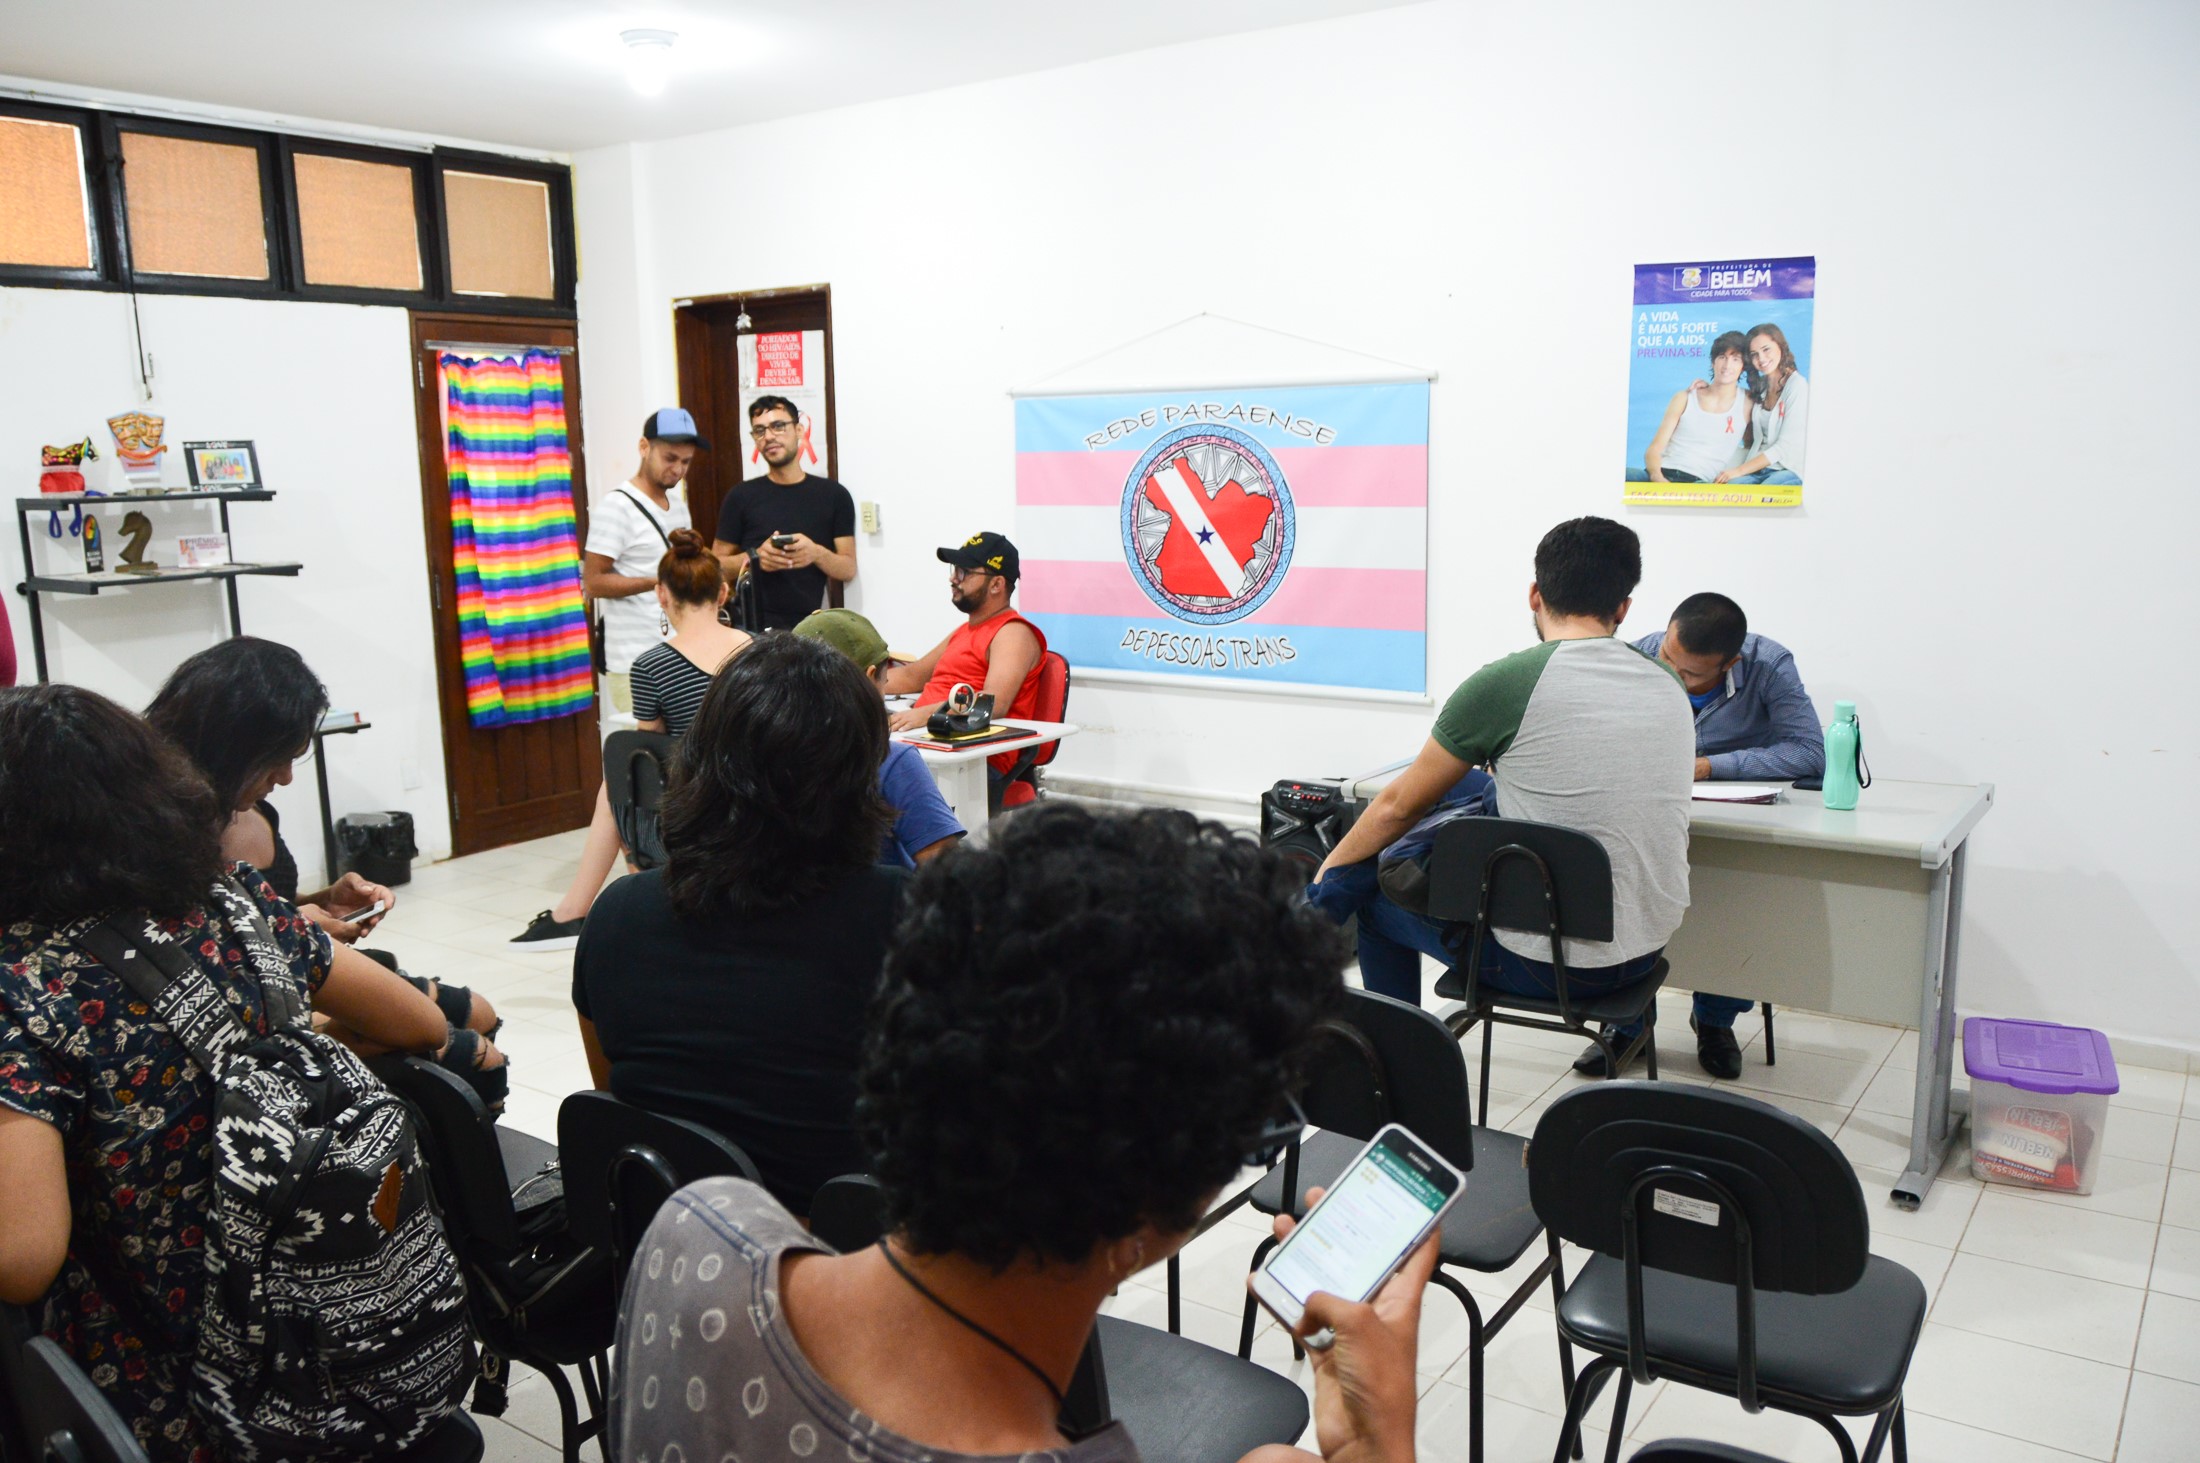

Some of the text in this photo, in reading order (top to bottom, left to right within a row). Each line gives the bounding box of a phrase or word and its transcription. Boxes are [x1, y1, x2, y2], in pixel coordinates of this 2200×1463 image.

[1710, 267, 1771, 289] BELÉM
[1691, 290, 1713, 298] CIDADE
[1731, 289, 1752, 297] TODOS
[1639, 311, 1679, 322] A VIDA
[1639, 322, 1718, 334] É MAIS FORTE
[761, 335, 798, 343] PORTADOR
[1638, 334, 1708, 347] QUE A AIDS.
[758, 343, 768, 352] DO
[1637, 347, 1706, 358] PREVINA-SE.
[761, 351, 788, 360] DIREITO
[765, 368, 787, 377] DEVER
[1085, 404, 1336, 450] REDE PARAENSE
[1687, 491, 1718, 503] TESTE
[1121, 629, 1297, 668] DE PESSOAS TRANS
[2002, 1135, 2055, 1159] NEBLIN
